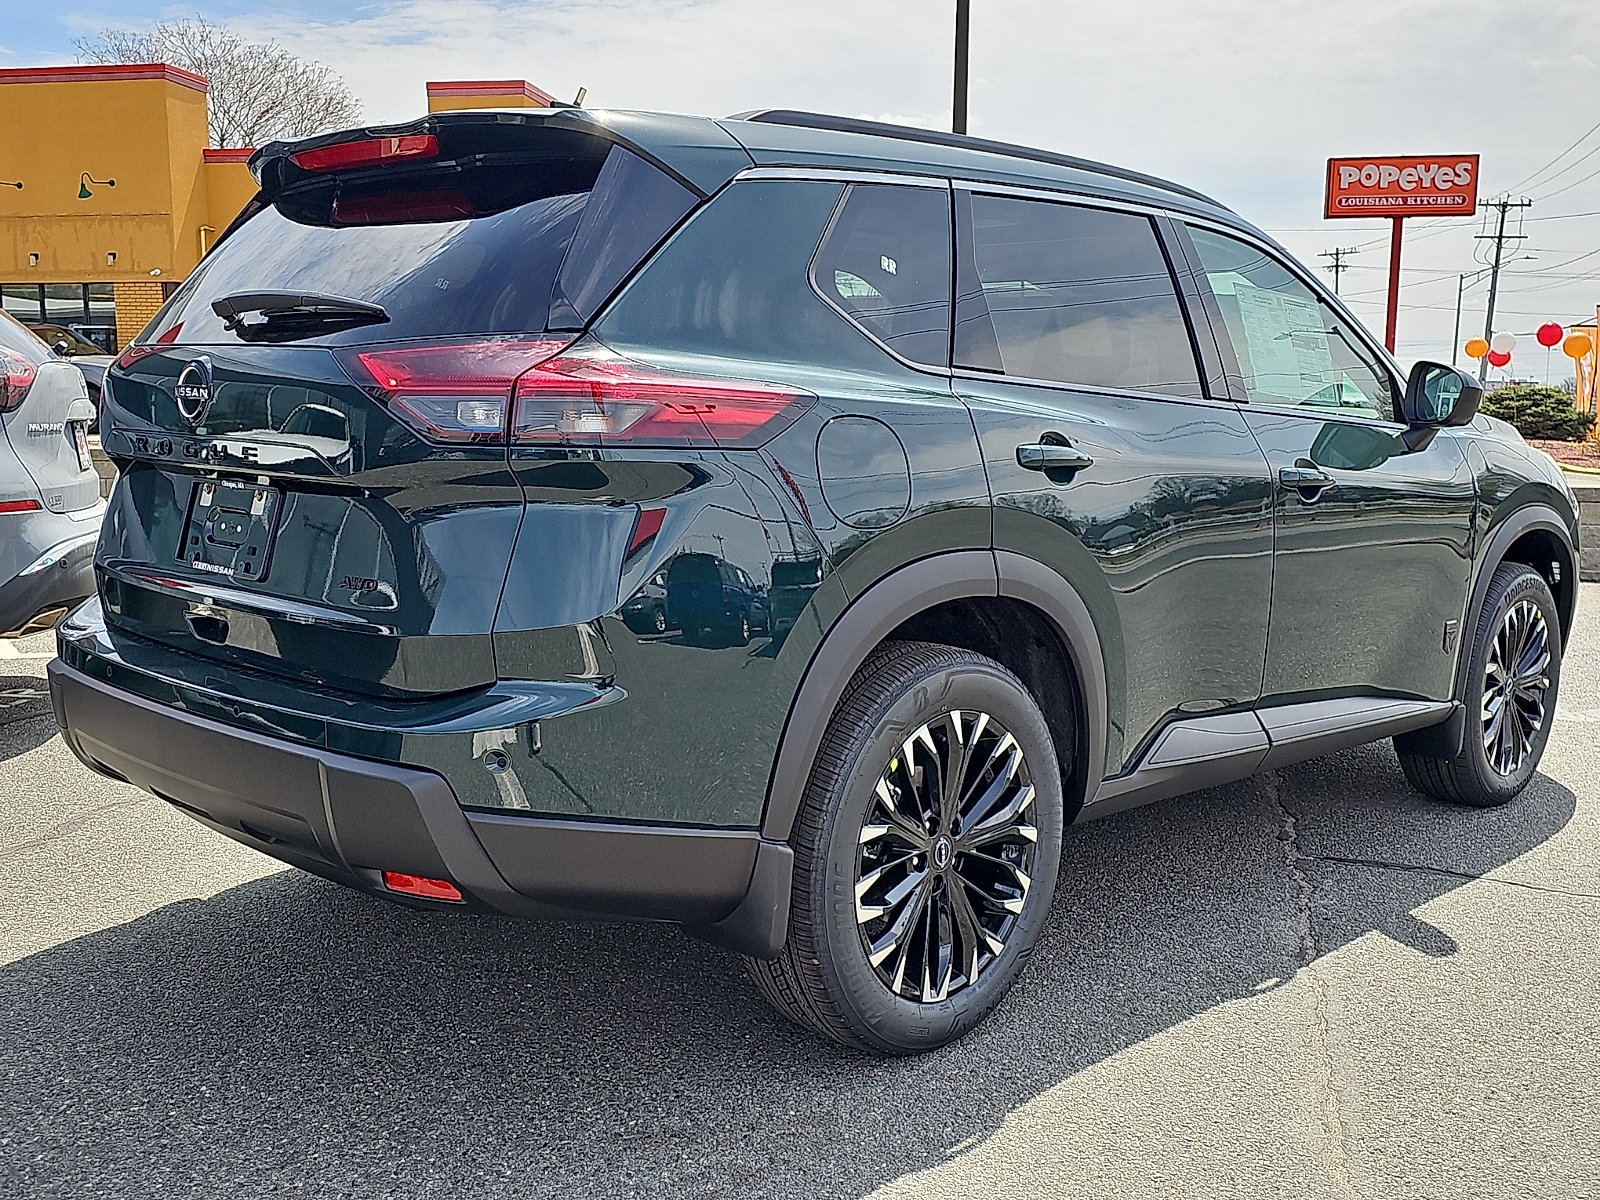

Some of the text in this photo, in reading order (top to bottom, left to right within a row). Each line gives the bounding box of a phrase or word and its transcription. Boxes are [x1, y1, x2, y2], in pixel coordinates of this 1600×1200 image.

[1341, 196, 1463, 206] LOUISIANA KITCHEN
[881, 255, 897, 275] RR
[135, 436, 259, 464] ROGUE
[207, 564, 235, 575] NISSAN
[338, 575, 378, 591] AWD
